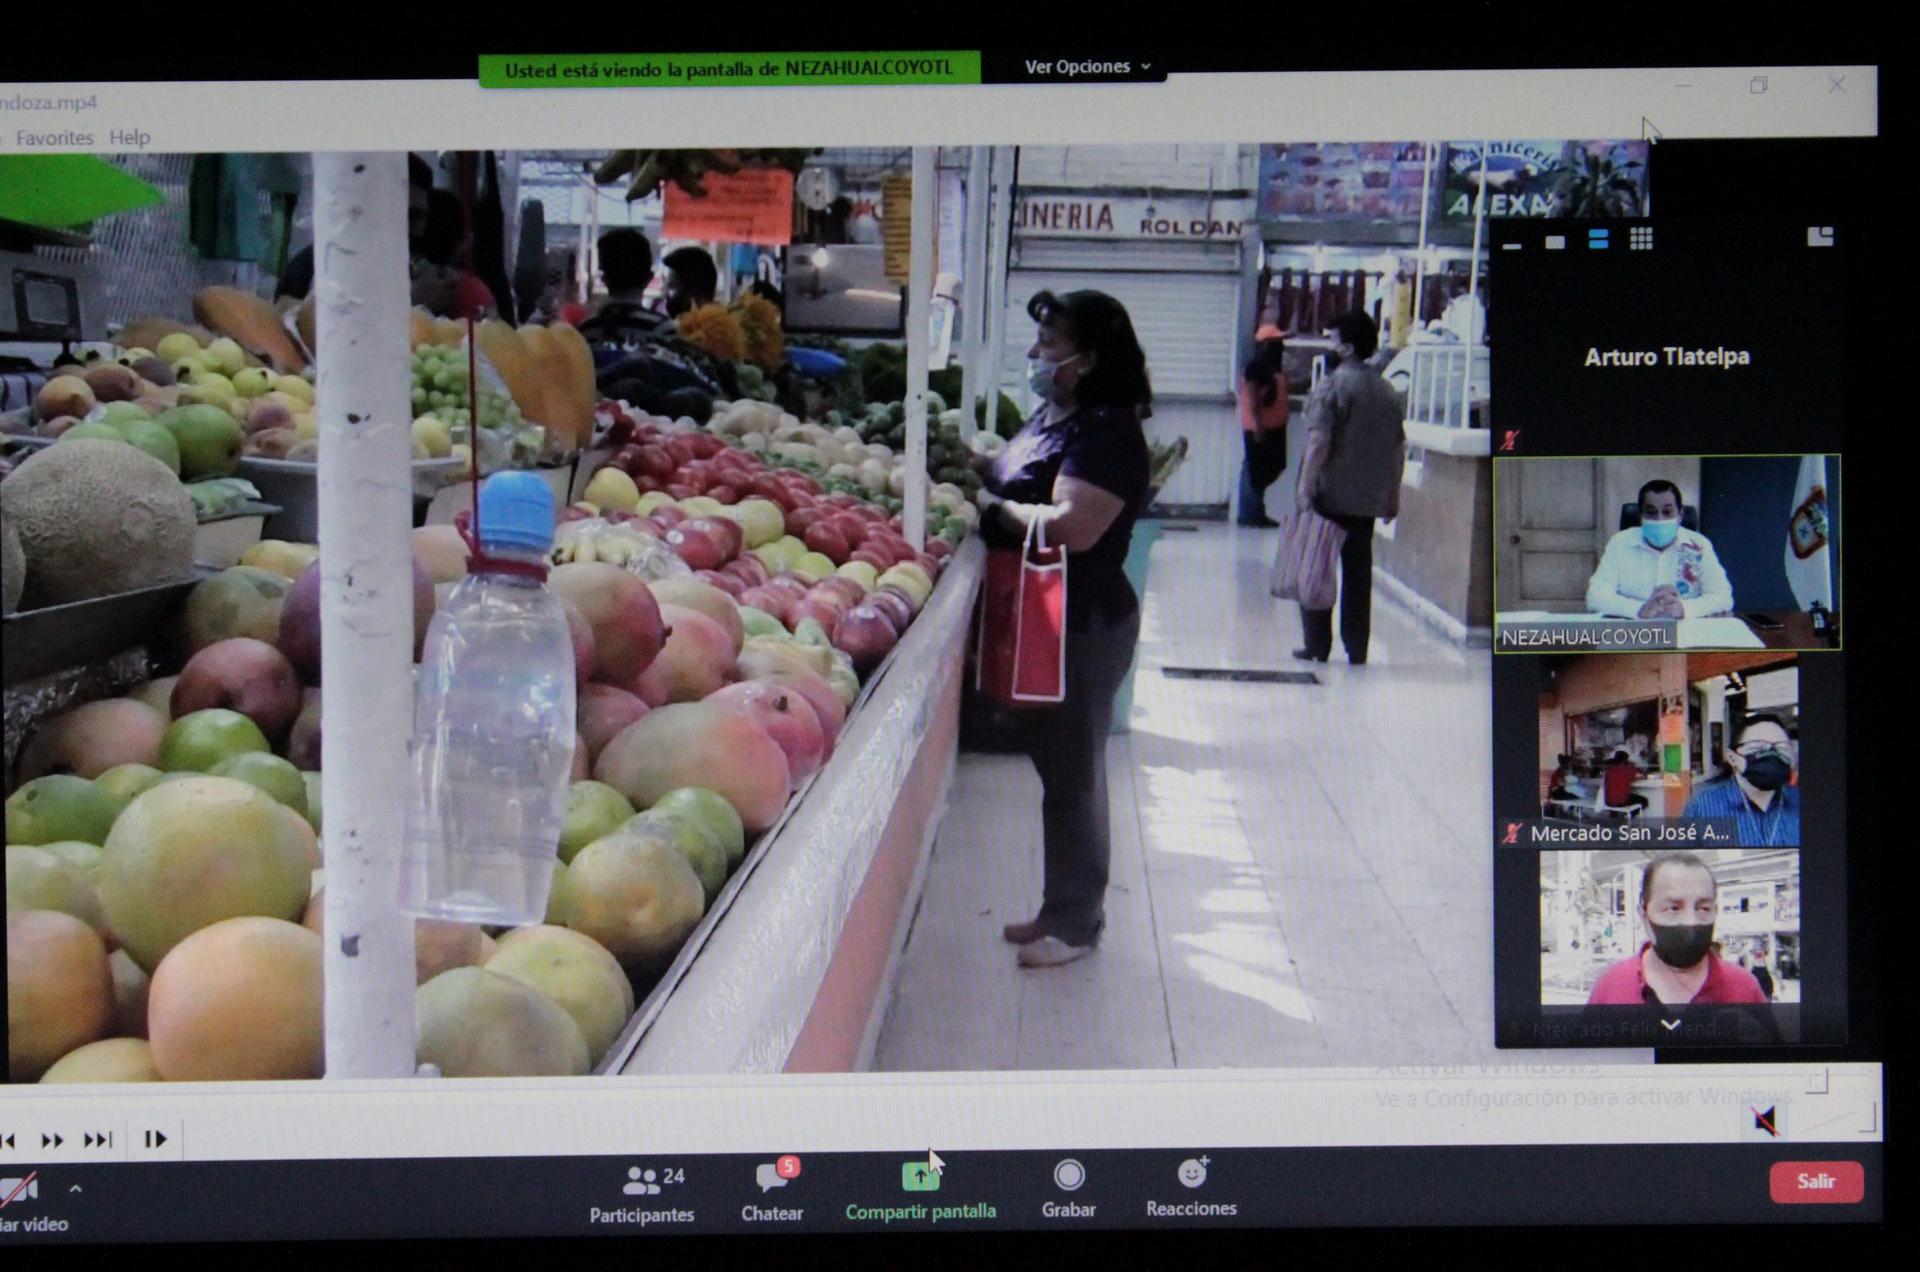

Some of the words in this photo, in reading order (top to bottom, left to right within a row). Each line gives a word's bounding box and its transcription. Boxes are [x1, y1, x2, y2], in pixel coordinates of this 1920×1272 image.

[505, 62, 557, 79] Usted
[562, 62, 599, 78] está
[603, 61, 662, 78] viendo
[668, 61, 682, 77] la
[687, 60, 753, 81] pantalla
[758, 61, 780, 77] de
[786, 59, 954, 76] NEZAHUALCOYOTL
[1025, 59, 1052, 75] Ver
[1056, 59, 1131, 77] Opciones
[16, 129, 95, 147] Favorites
[109, 128, 151, 149] Help
[1140, 218, 1243, 235] ROLDAN
[1585, 346, 1658, 366] Arturo
[1663, 346, 1751, 369] Tlatelpa
[1502, 627, 1671, 646] NEZAHUALCOYOTL
[1531, 825, 1613, 842] Mercado
[1618, 825, 1651, 841] San
[1656, 823, 1697, 841] José
[1533, 1020, 1614, 1038] Mercado
[1375, 1089, 1401, 1107] Ve
[1406, 1093, 1418, 1107] a
[1574, 1090, 1619, 1110] para
[784, 1158, 794, 1173] 5
[662, 1167, 686, 1185] 24
[1797, 1172, 1836, 1189] Salir
[590, 1206, 695, 1228] Participantes
[741, 1205, 804, 1222] Chatear
[845, 1203, 928, 1224] Compartir
[932, 1202, 998, 1224] pantalla
[1042, 1201, 1097, 1218] Grabar
[1146, 1200, 1238, 1217] Reacciones
[22, 1215, 69, 1232] video
